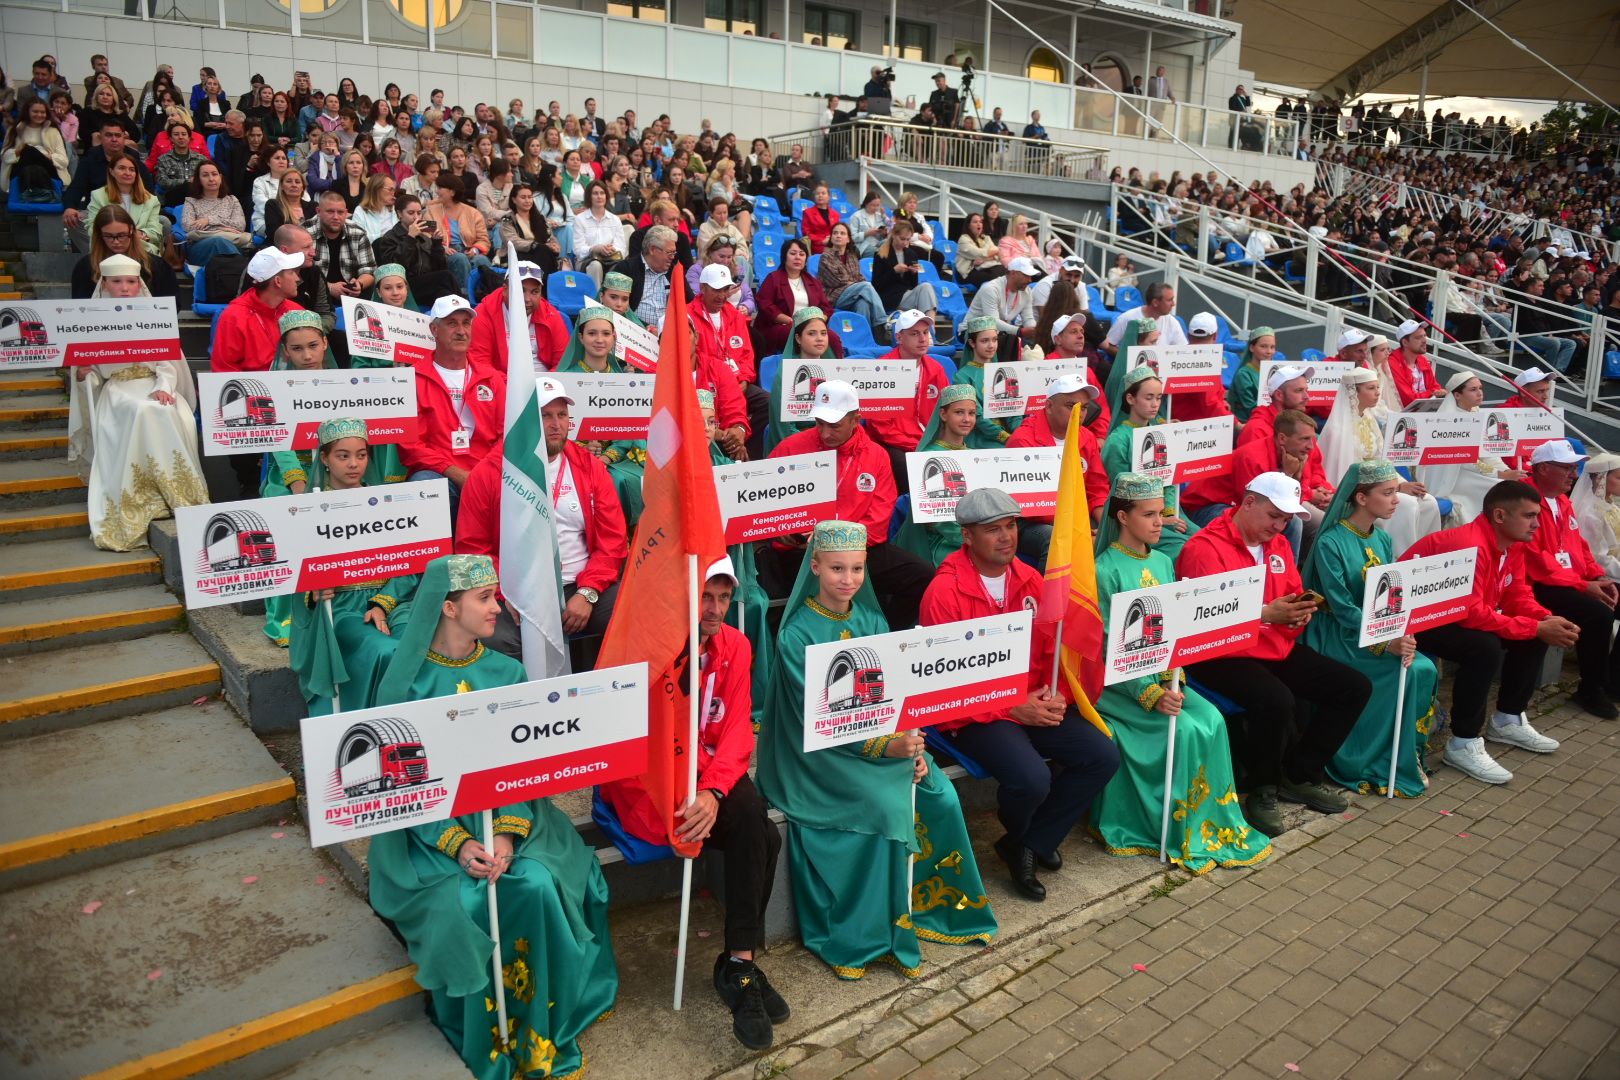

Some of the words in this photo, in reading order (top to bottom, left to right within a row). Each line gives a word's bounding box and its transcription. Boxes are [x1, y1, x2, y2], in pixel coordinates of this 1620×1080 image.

[1345, 119, 1353, 129] 9
[56, 324, 133, 333] Набережные
[136, 322, 173, 330] Челны
[73, 348, 125, 358] Республика
[128, 347, 169, 356] Татарстан
[1170, 360, 1213, 370] Ярославль
[851, 380, 896, 390] Саратов
[293, 395, 405, 411] Новоульяновск
[213, 430, 247, 439] ЛУЧШИЙ
[250, 429, 289, 437] ВОДИТЕЛЬ
[369, 427, 404, 436] область
[1431, 430, 1470, 438] Смоленск
[1526, 423, 1551, 431] Ачинск
[230, 437, 274, 445] ГРУЗОВИКА
[1186, 439, 1217, 451] Липецк
[1000, 471, 1051, 483] Липецк
[502, 470, 536, 504] ИНЫЙ
[737, 482, 815, 503] Кемерово
[753, 510, 808, 525] Кемеровская
[316, 515, 419, 539] Черкесск
[743, 525, 776, 537] область
[778, 519, 817, 532] (Кузбасс)
[308, 546, 440, 572] Карачаево-Черкесская
[196, 575, 241, 589] ЛУЧШИЙ
[244, 567, 293, 581] ВОДИТЕЛЬ
[343, 561, 410, 579] Республика
[219, 579, 273, 593] ГРУЗОВИКА
[1410, 574, 1469, 597] Новосибирск
[1193, 597, 1239, 621] Лесной
[1177, 640, 1225, 657] Свердловская
[1226, 632, 1251, 644] область
[911, 649, 1011, 677] Чебоксары
[907, 699, 961, 717] Чувашская
[963, 687, 1017, 707] республика
[815, 715, 852, 730] ЛУЧШИЙ
[854, 706, 896, 721] ВОДИТЕЛЬ
[833, 719, 878, 734] ГРУЗОВИКА
[511, 717, 581, 744] Омск
[495, 773, 549, 792] Омская
[554, 760, 608, 780] область
[325, 801, 381, 820] ЛУЧШИЙ
[386, 787, 448, 808] ВОДИТЕЛЬ
[354, 803, 423, 824] ГРУЗОВИКА
